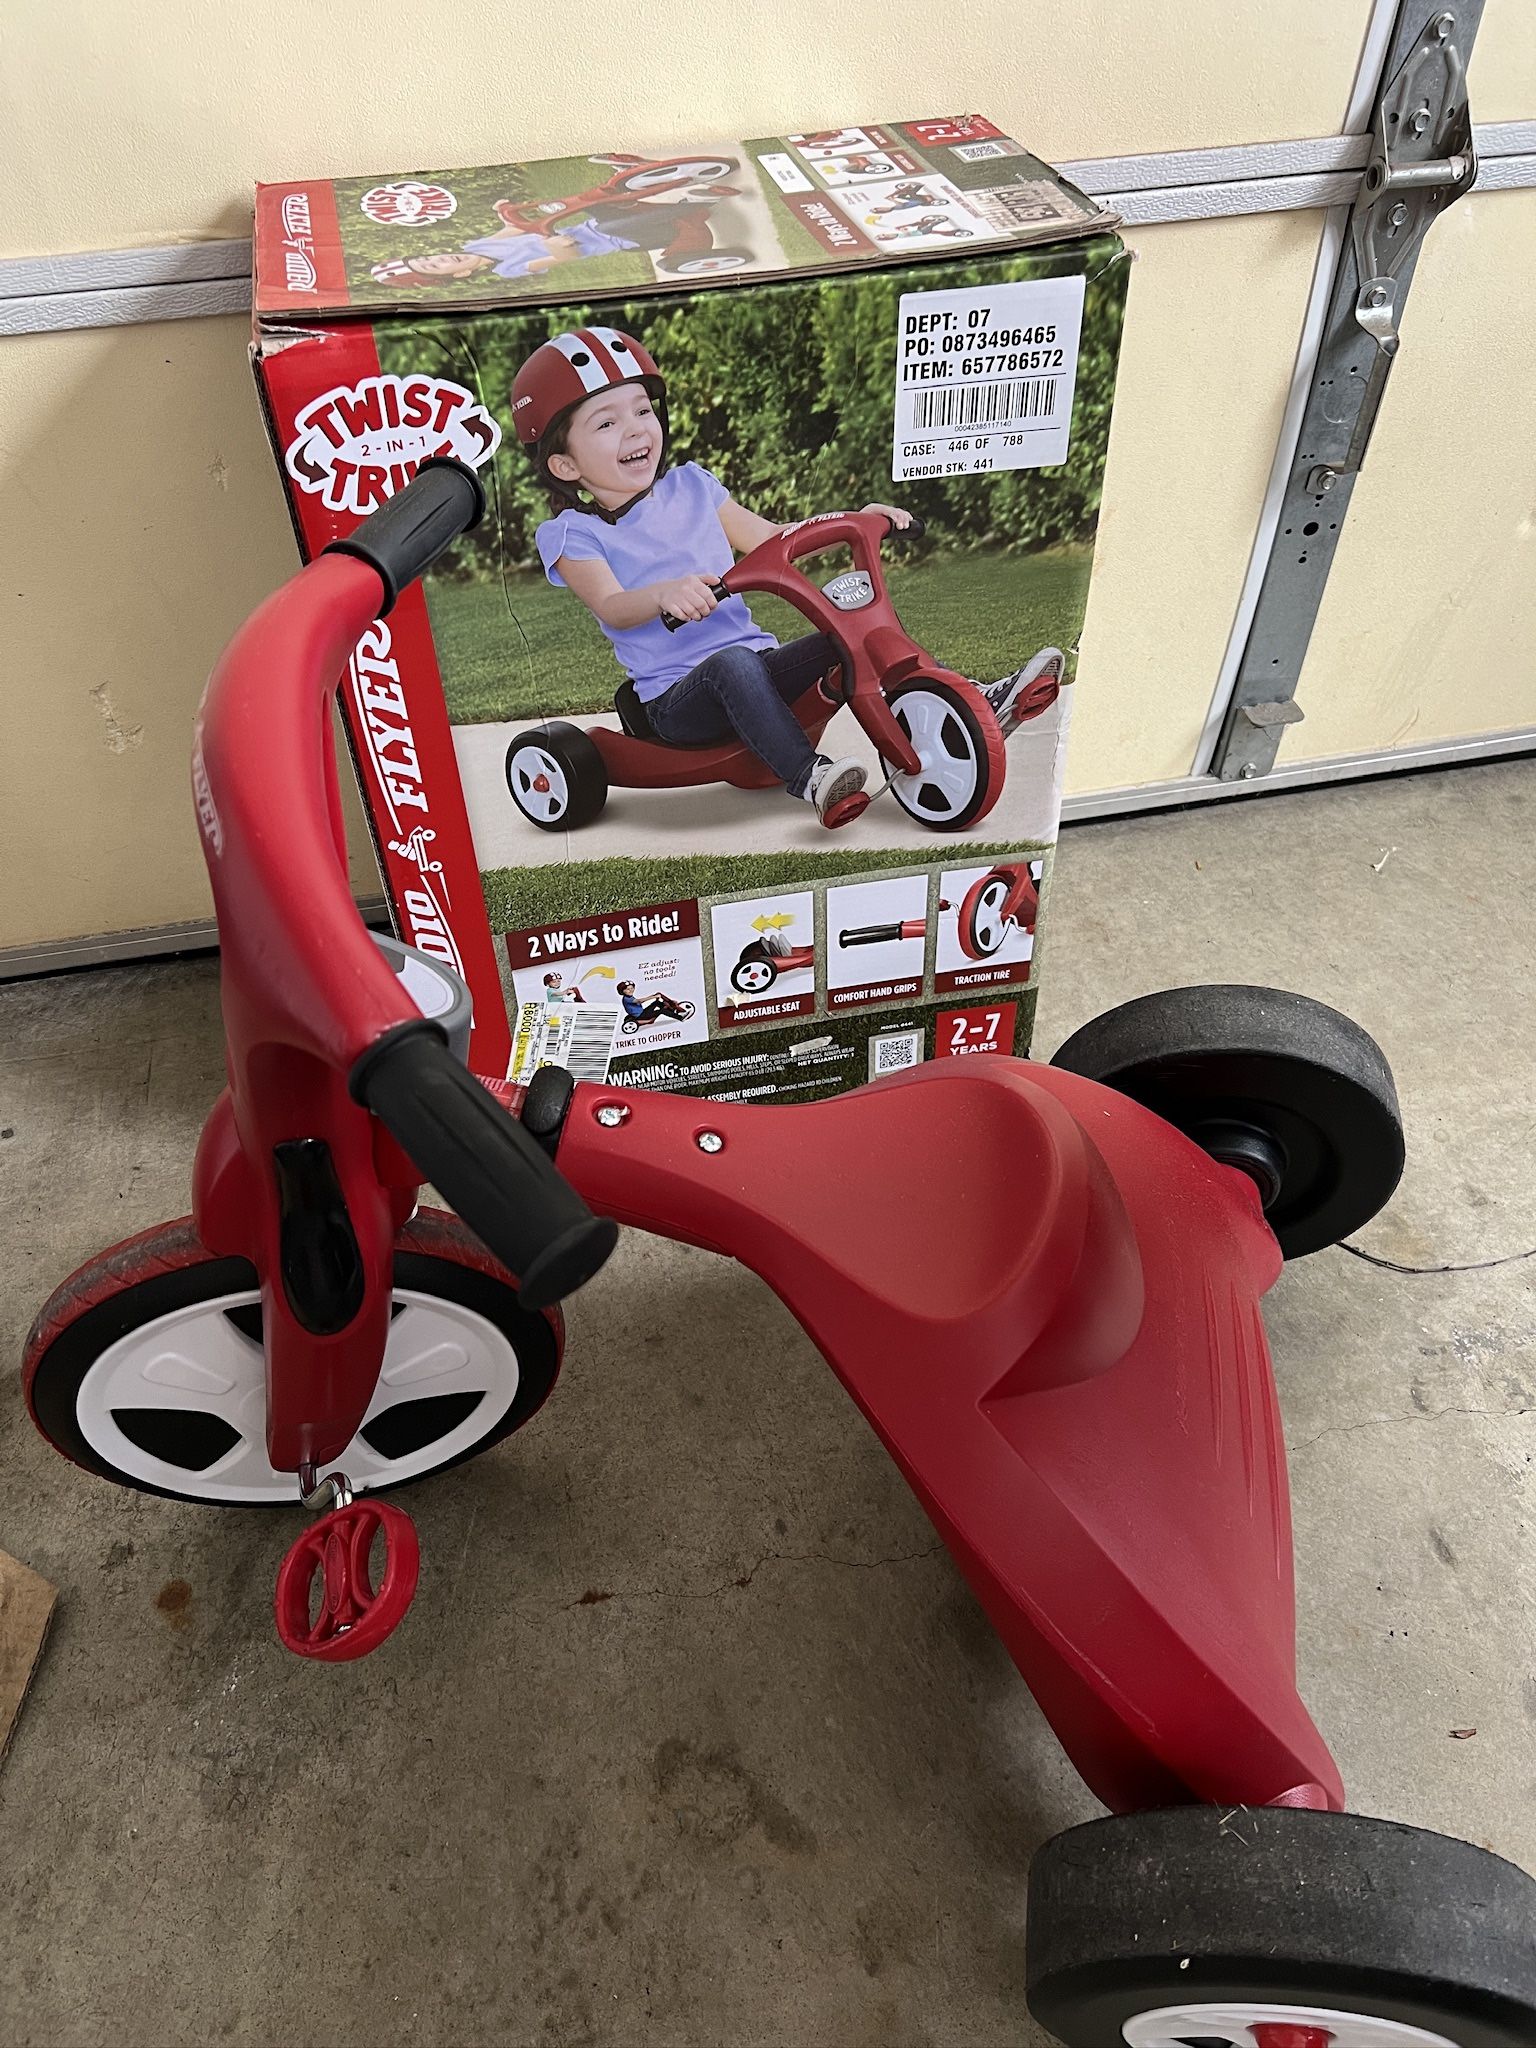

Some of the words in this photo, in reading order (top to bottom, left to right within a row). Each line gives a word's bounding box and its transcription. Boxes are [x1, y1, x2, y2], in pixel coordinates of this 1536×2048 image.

[906, 312, 958, 335] DEPT:
[968, 308, 991, 329] 07
[905, 337, 935, 358] PO:
[942, 325, 1056, 353] 0873496465
[903, 360, 954, 381] ITEM:
[962, 348, 1064, 376] 657786572
[303, 383, 466, 450] TWIST
[903, 444, 936, 458] CASE:
[948, 440, 969, 452] 446
[975, 437, 990, 449] OF
[1003, 434, 1024, 447] 788
[903, 464, 943, 478] VENDOR
[946, 461, 967, 473] STK:
[973, 458, 993, 470] 441
[832, 577, 861, 593] TWIST
[839, 588, 868, 603] TRIKE
[527, 936, 542, 958] 2
[543, 928, 599, 954] Ways
[602, 923, 624, 944] to
[628, 911, 680, 939] Ride!
[656, 965, 676, 973] tools
[955, 972, 991, 985] TRACTION
[993, 970, 1011, 980] TIRE
[833, 990, 869, 1004] COMFORT
[870, 987, 893, 999] HAND
[893, 983, 917, 995] GRIPS
[733, 1004, 781, 1021] ADJUSTABLE
[782, 1001, 801, 1013] SEAT
[616, 1039, 637, 1049] TRIKE
[637, 1037, 647, 1045] TO
[648, 1030, 681, 1043] CHOPPER
[950, 1040, 997, 1056] YEARS
[813, 1053, 850, 1064] QUANTITY:
[608, 1063, 679, 1087] WARNING:
[680, 1067, 689, 1076] TO
[690, 1063, 712, 1075] AVOID
[713, 1058, 741, 1070] SERIOUS
[742, 1053, 769, 1065] INJURY:
[707, 1090, 741, 1102] ASSEMBLY
[742, 1084, 778, 1098] REQUIRED.
